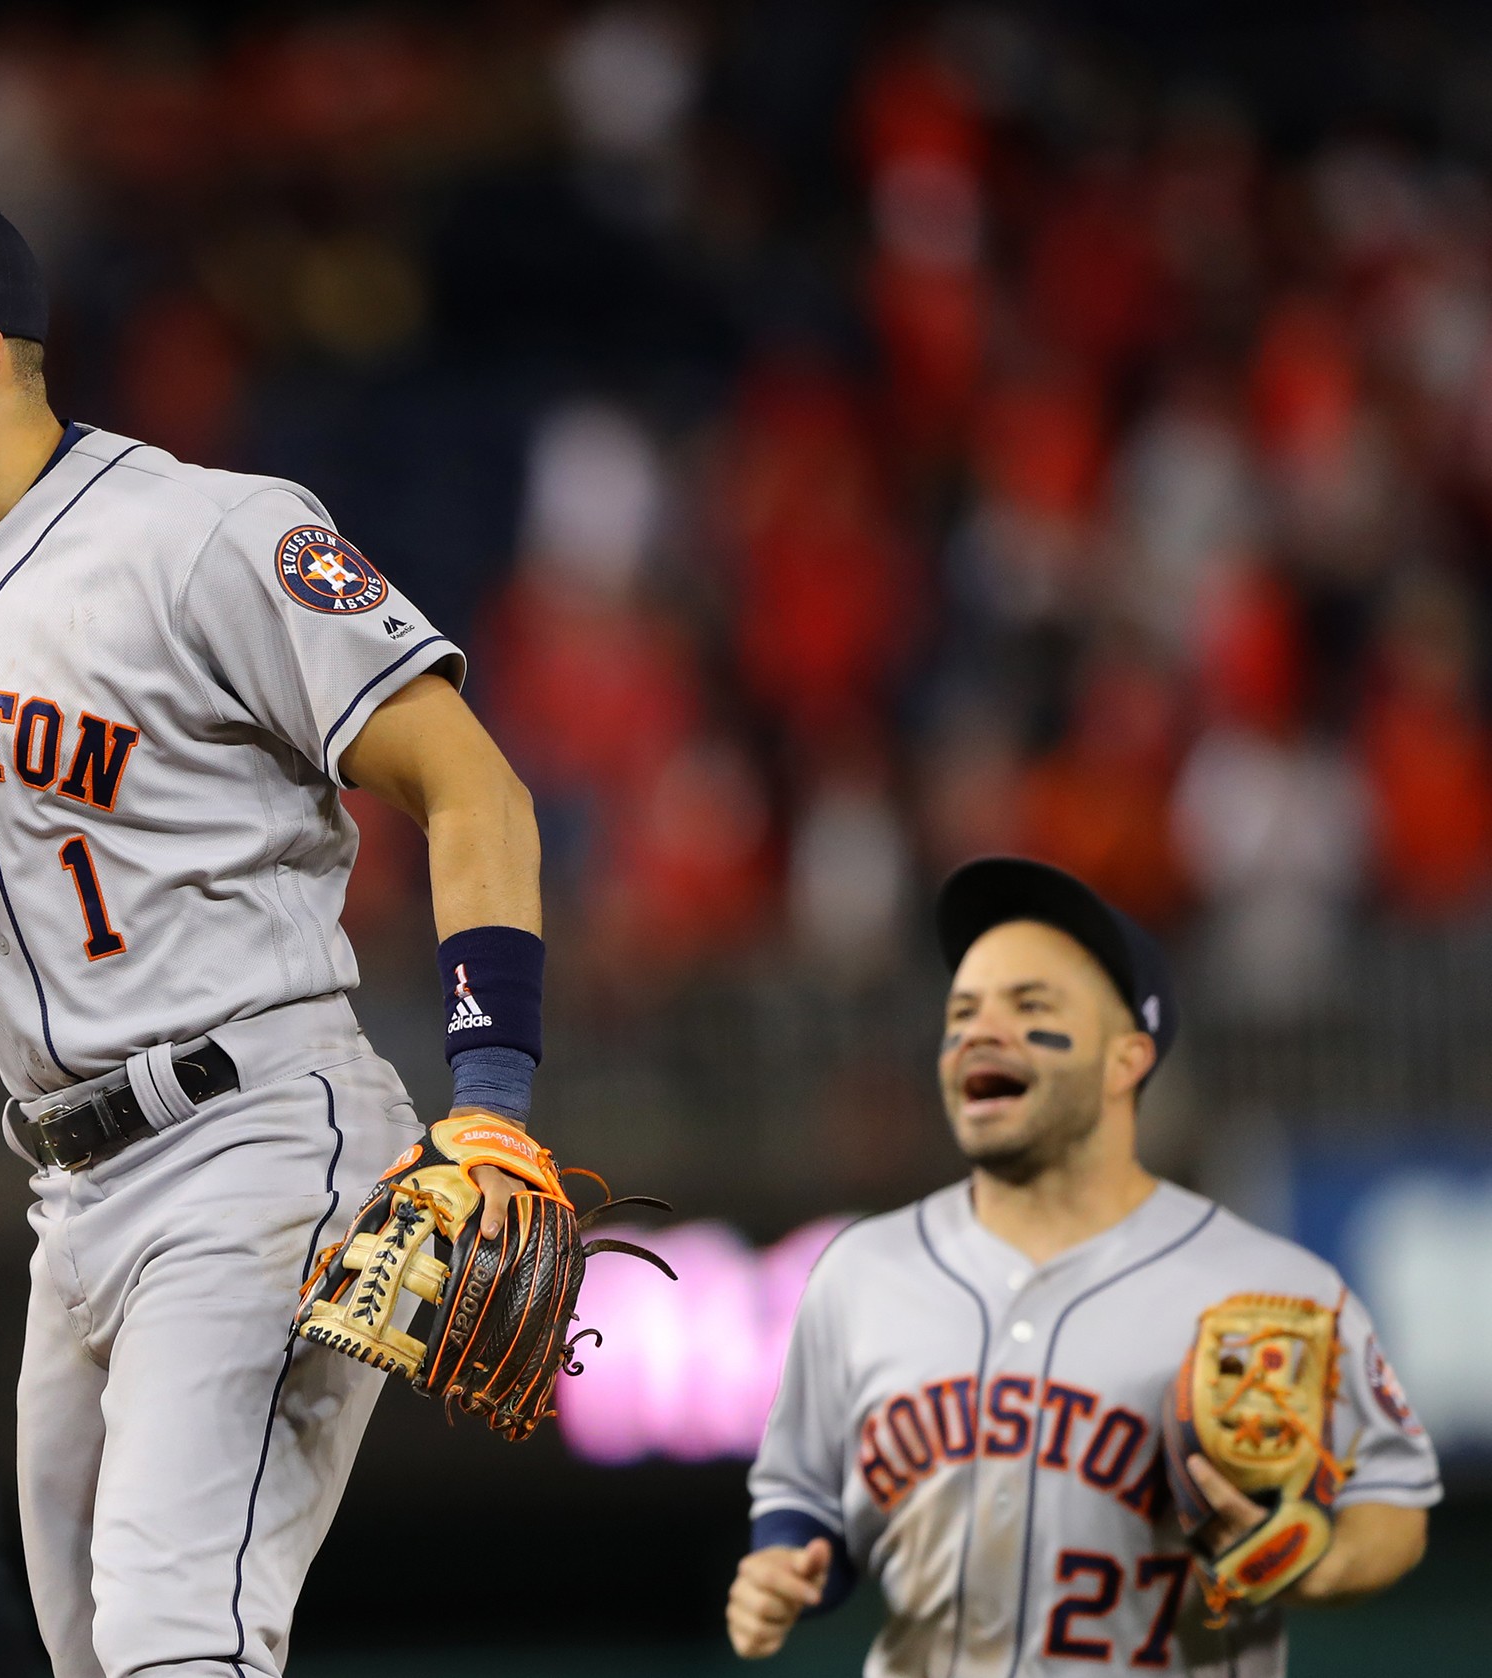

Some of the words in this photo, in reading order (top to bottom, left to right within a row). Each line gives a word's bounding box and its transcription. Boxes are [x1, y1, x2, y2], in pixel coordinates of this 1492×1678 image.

[282, 531, 338, 575] HOUSTON
[333, 576, 382, 610] ASTROS
[59, 834, 127, 962] 1
[447, 1013, 493, 1034] adidas
[449, 1265, 491, 1349] A2000
[1043, 1549, 1193, 1667] 27
